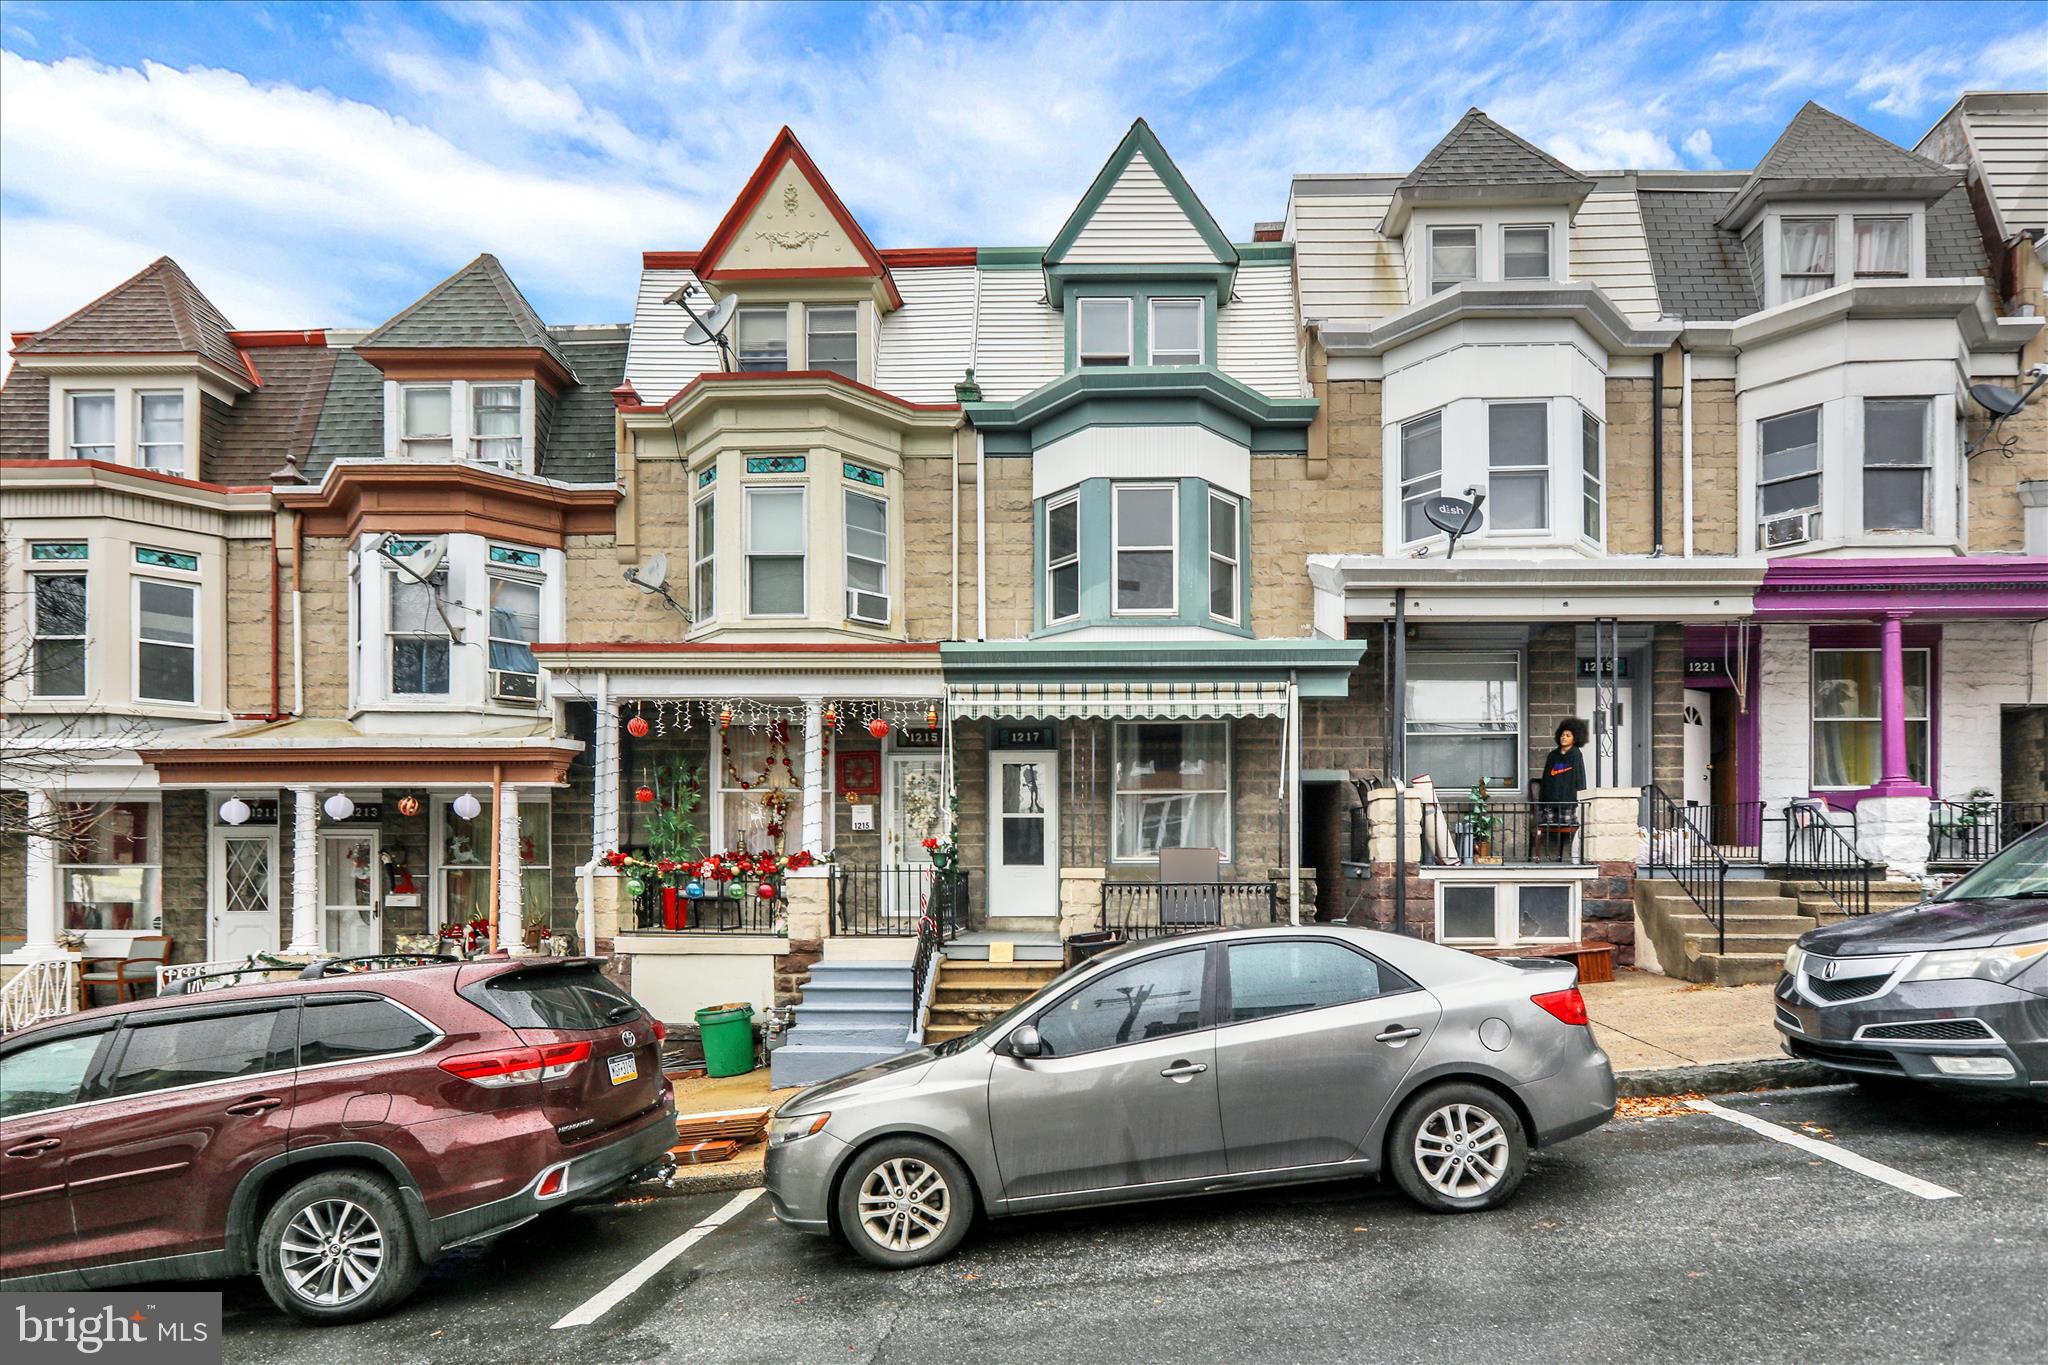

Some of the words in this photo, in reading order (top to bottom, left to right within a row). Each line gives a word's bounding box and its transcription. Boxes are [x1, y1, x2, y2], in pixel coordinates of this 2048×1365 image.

[1439, 505, 1464, 515] dish
[1689, 662, 1715, 672] 1221
[910, 732, 938, 742] 1215
[1012, 731, 1039, 742] 1217
[252, 807, 277, 817] 1211
[354, 807, 378, 817] 213
[854, 822, 870, 830] 1215
